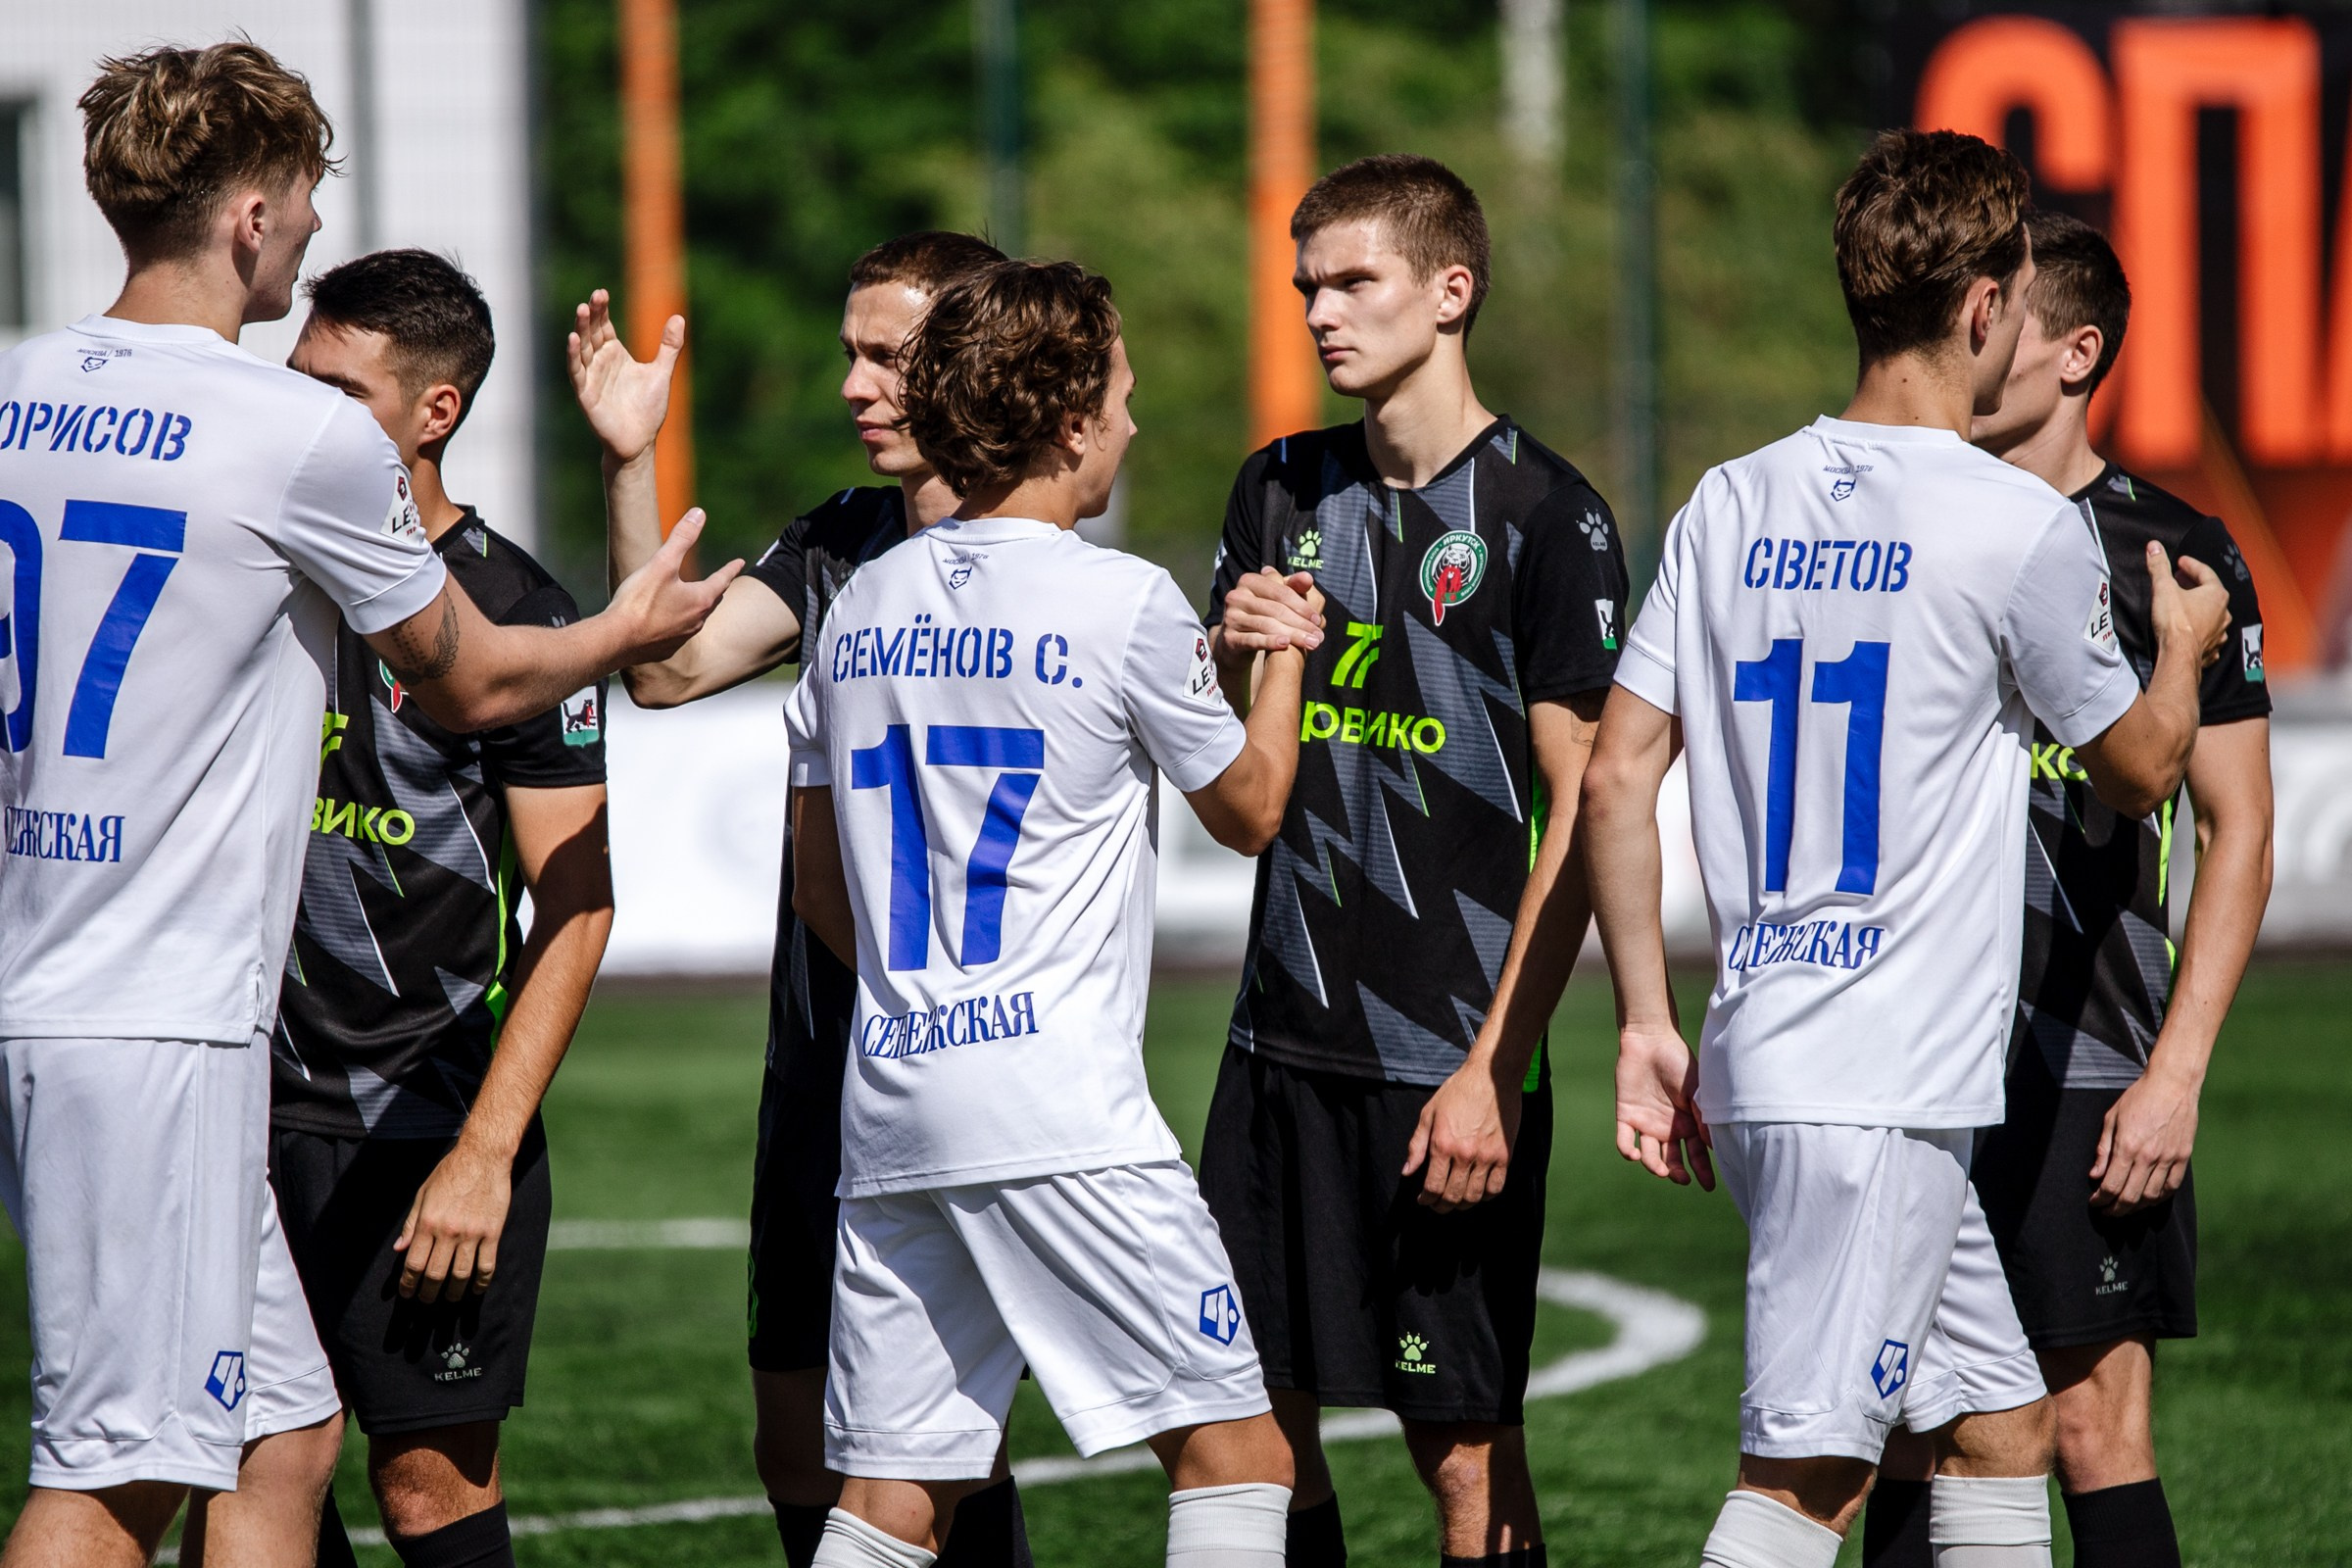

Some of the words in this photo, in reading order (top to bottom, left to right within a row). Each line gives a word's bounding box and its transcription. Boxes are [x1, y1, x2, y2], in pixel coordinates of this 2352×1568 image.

[1443, 534, 1481, 550] ИРКУТСК
[1744, 537, 1913, 593] СВЕТОВ
[832, 613, 1013, 683] СЕМЁНОВ
[1035, 633, 1083, 689] С.
[1734, 638, 1890, 896] 11
[851, 723, 1045, 972] 17
[434, 1367, 483, 1382] KELME
